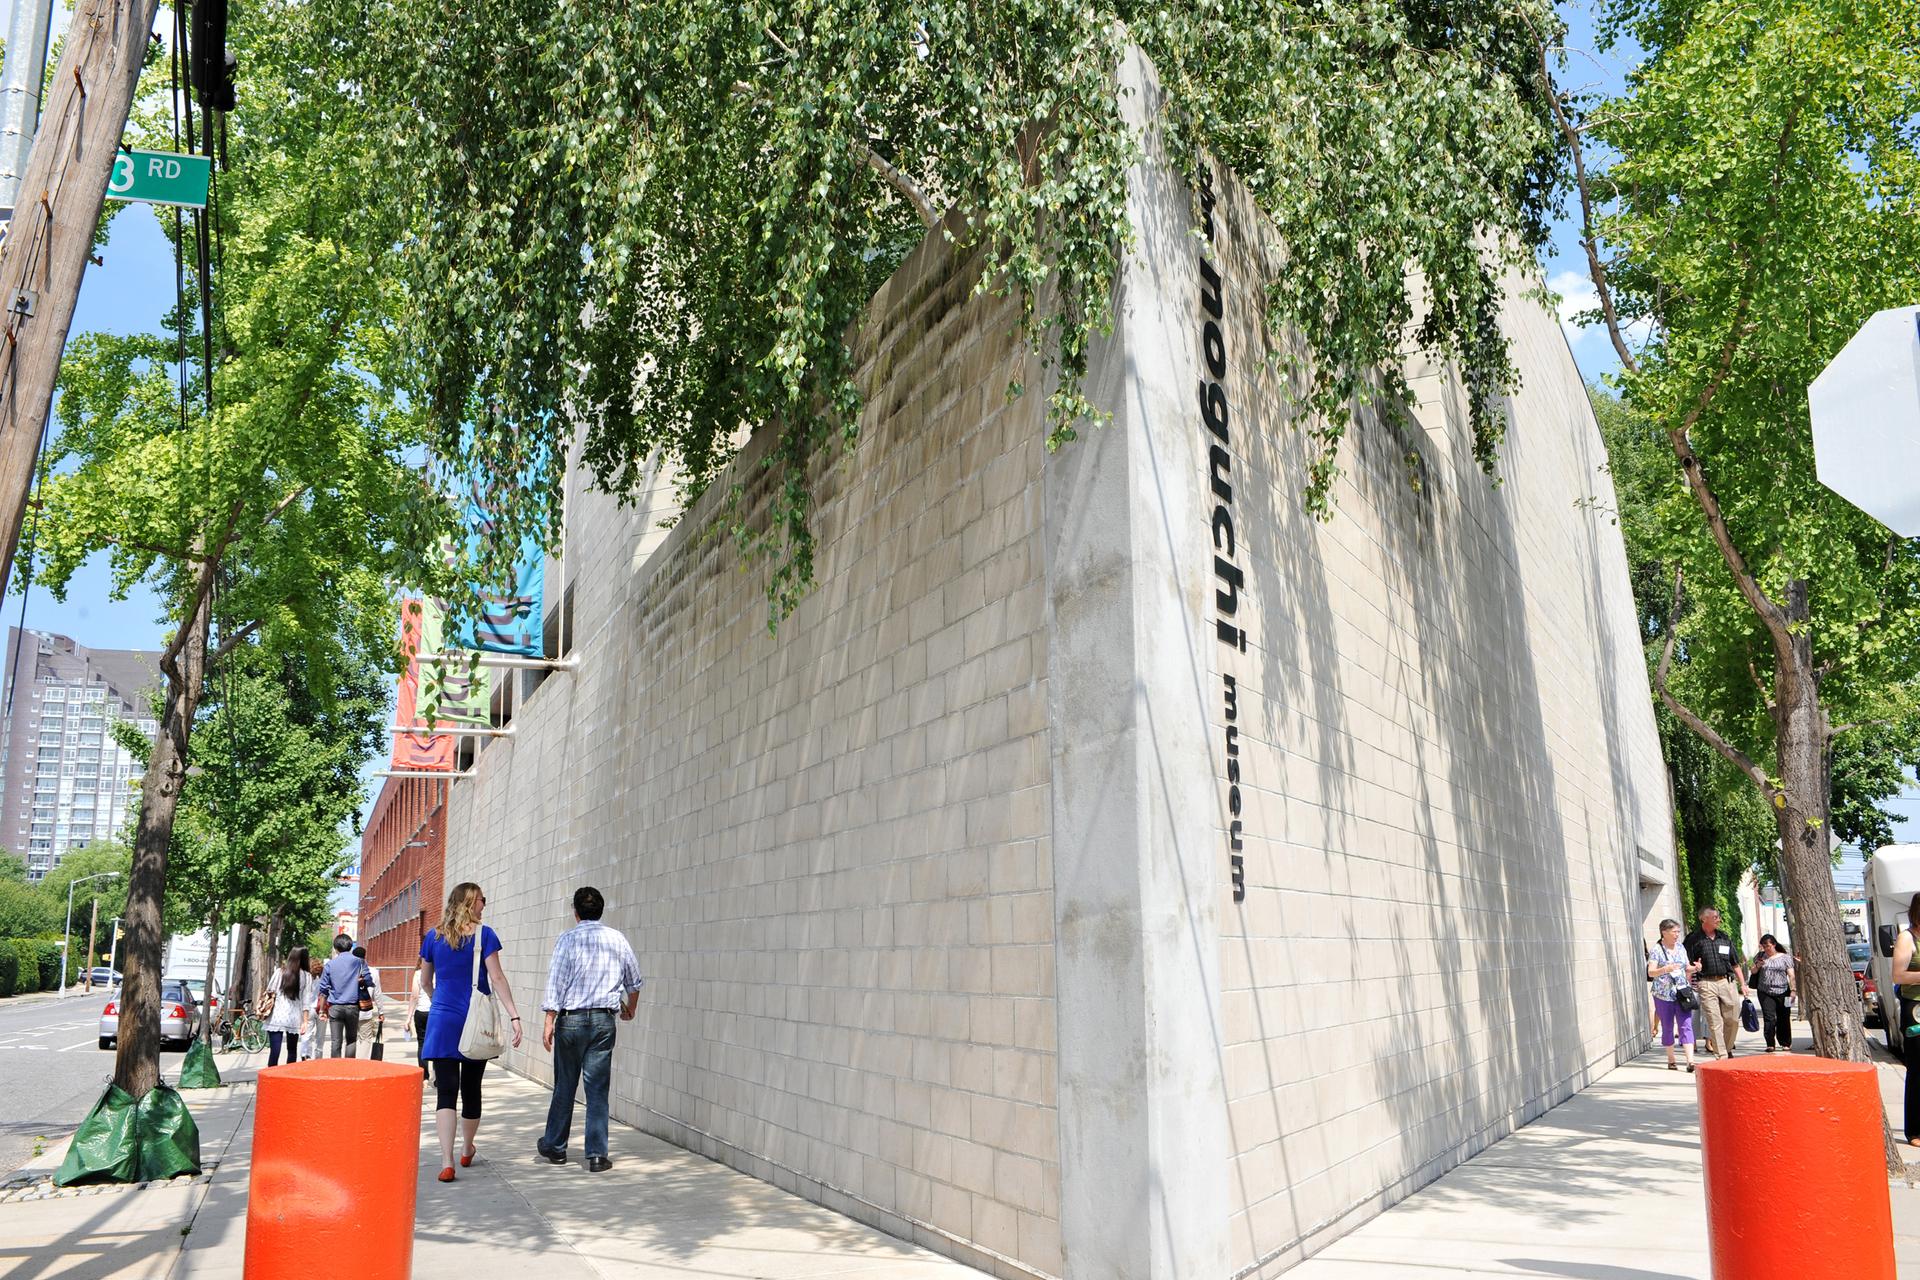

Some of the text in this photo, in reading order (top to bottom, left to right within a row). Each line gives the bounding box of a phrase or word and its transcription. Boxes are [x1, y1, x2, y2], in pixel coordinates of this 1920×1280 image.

[148, 158, 181, 179] RD
[1199, 256, 1247, 653] noguchi
[1223, 673, 1245, 903] museum
